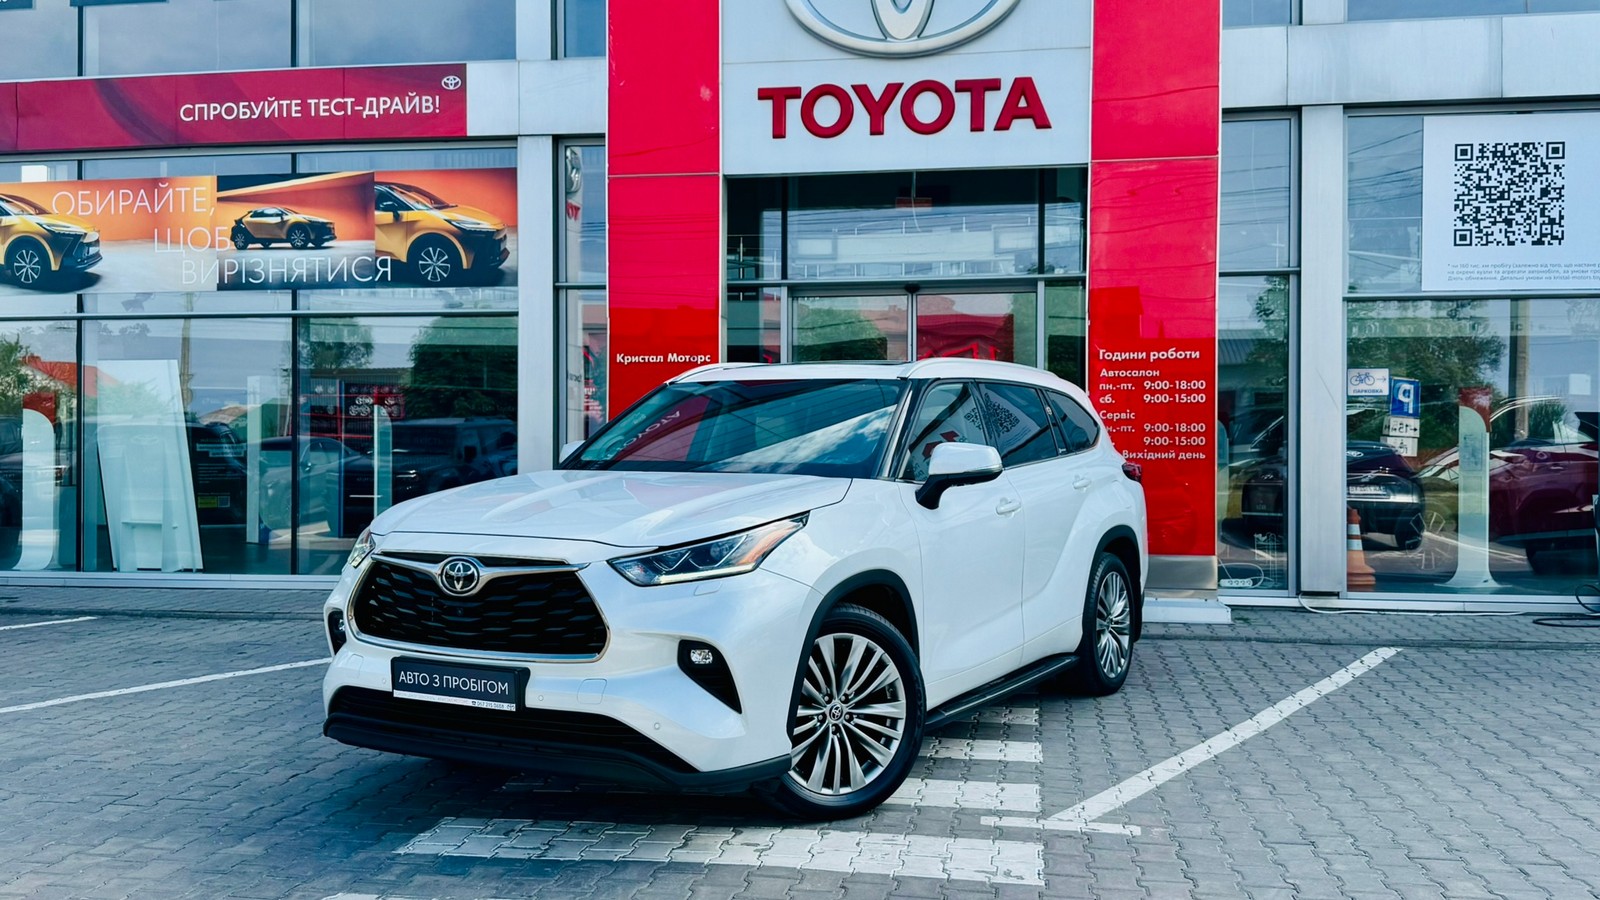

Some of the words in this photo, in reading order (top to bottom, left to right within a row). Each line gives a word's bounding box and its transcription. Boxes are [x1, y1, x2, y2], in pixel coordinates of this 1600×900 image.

[179, 96, 302, 121] СПРОБУЙТЕ
[307, 91, 440, 119] ТЕСТ-ДРАЙВ!
[757, 76, 1052, 139] TOYOTA
[52, 181, 216, 217] ОБИРАЙТЕ,
[154, 225, 231, 256] ЩОБ
[182, 256, 393, 285] ВИРІЗНЯТИСЯ
[616, 353, 664, 365] Кристал
[667, 352, 711, 364] Моторс
[1099, 349, 1146, 361] Години
[1150, 347, 1200, 362] роботи
[1100, 368, 1160, 377] Автосалон
[1143, 380, 1206, 390] 9:00-18:00
[1099, 394, 1115, 404] сб.
[1143, 393, 1206, 403] 9:00-15:00
[1099, 409, 1136, 421] Сервіс
[1106, 425, 1136, 433] н.-пт.
[1143, 422, 1206, 432] 9:00-18:00
[1143, 436, 1206, 446] 9:00-15:00
[1122, 449, 1176, 460] Вихідний
[1178, 451, 1206, 460] день
[399, 670, 430, 686] АВТО
[443, 675, 509, 695] ПРОБІГОМ
